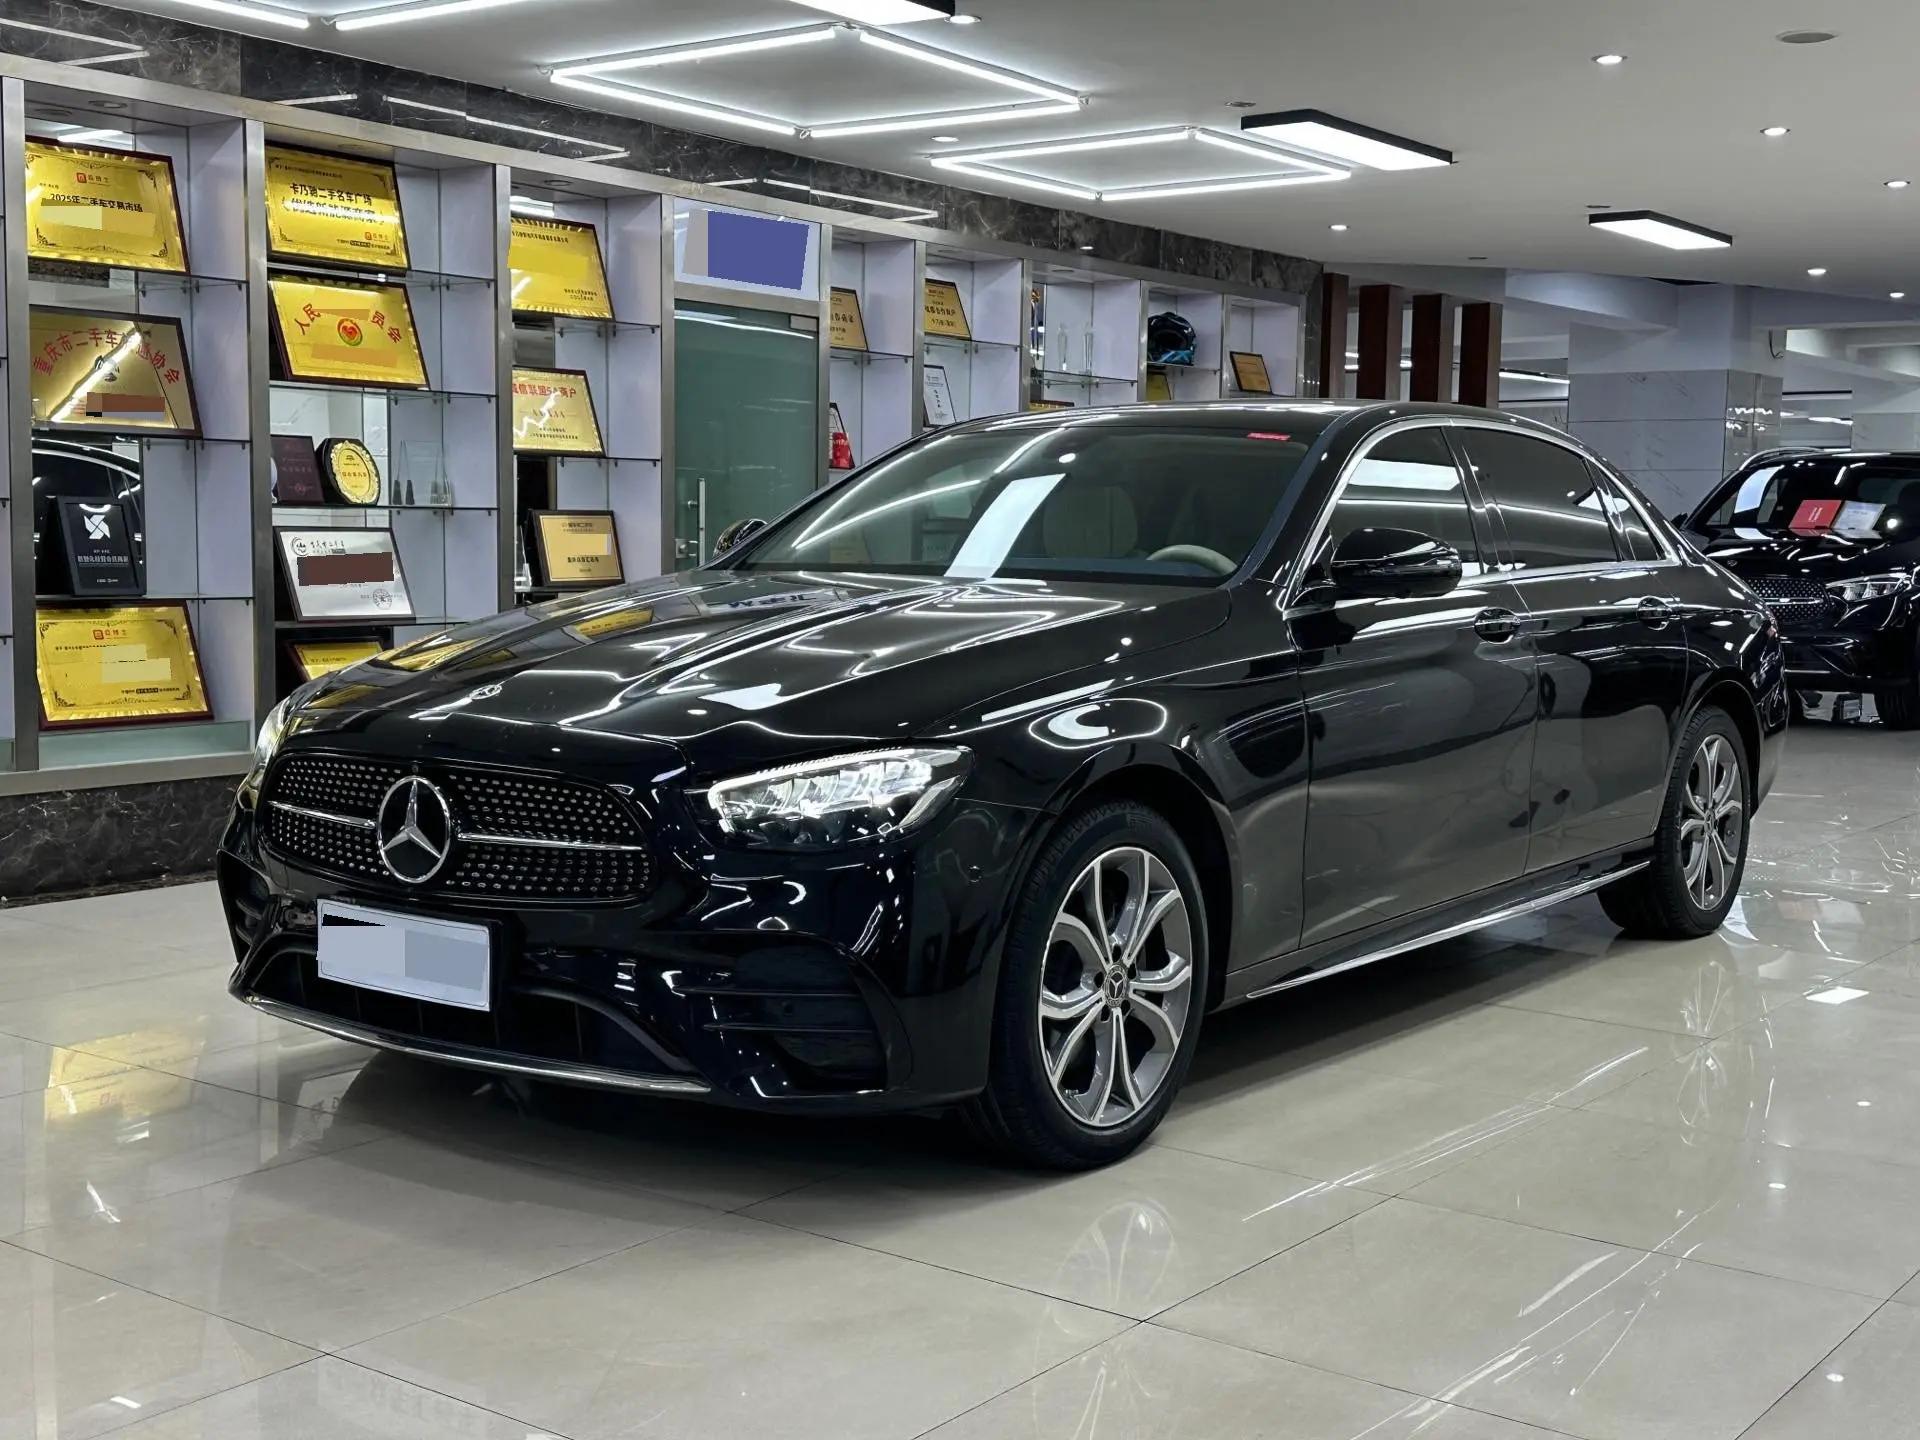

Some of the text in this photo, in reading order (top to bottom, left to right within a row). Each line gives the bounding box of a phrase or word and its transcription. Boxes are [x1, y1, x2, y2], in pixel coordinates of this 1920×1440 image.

[294, 303, 321, 336] 人民
[370, 310, 402, 344] 员会
[33, 327, 181, 384] 重庆市二手车通协会
